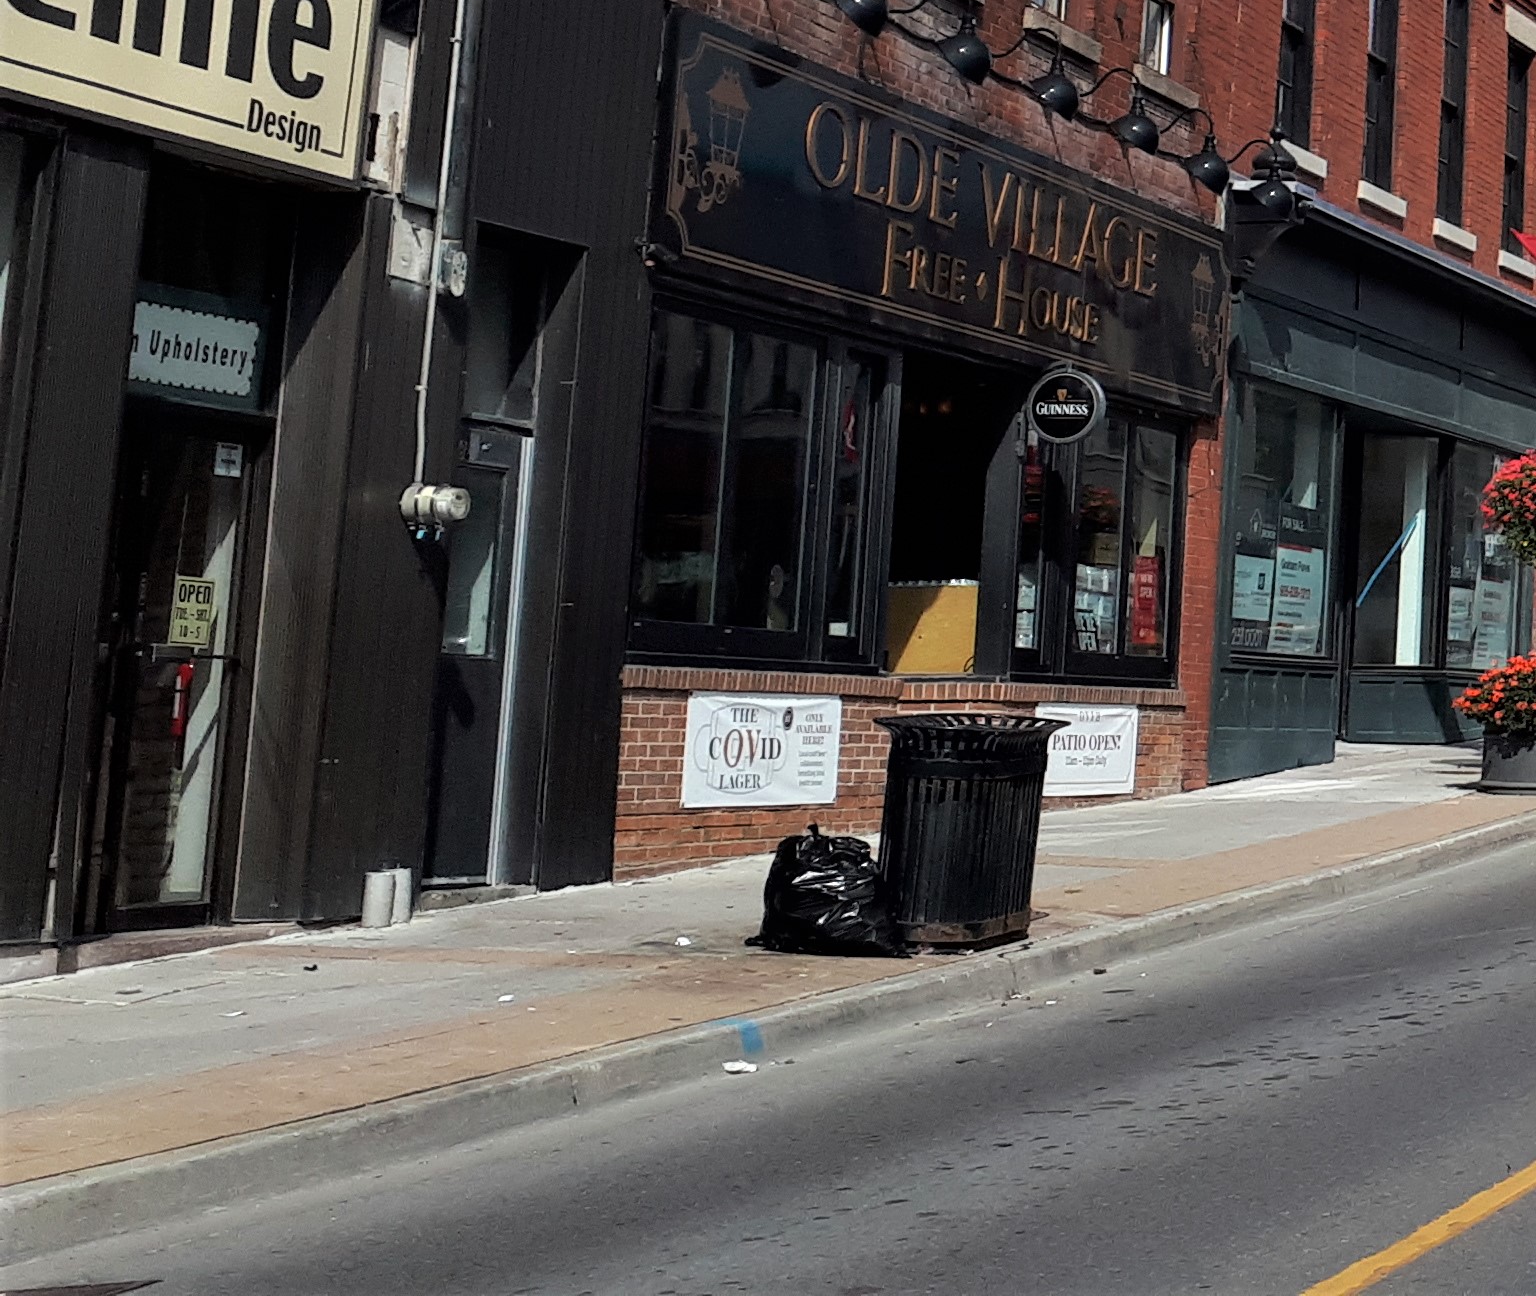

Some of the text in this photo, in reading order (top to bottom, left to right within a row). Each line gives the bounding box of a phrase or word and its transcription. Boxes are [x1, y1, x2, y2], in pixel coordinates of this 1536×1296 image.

[247, 98, 322, 153] Design
[805, 101, 1159, 296] OLDE VILLAGE
[149, 329, 248, 375] Upholstery
[1035, 401, 1089, 417] GUINNESS
[178, 583, 211, 604] OPEN
[730, 707, 759, 723] THE
[708, 728, 782, 768] COVID
[1052, 734, 1122, 751] PATIO OPEN!
[719, 773, 761, 790] LAGER
